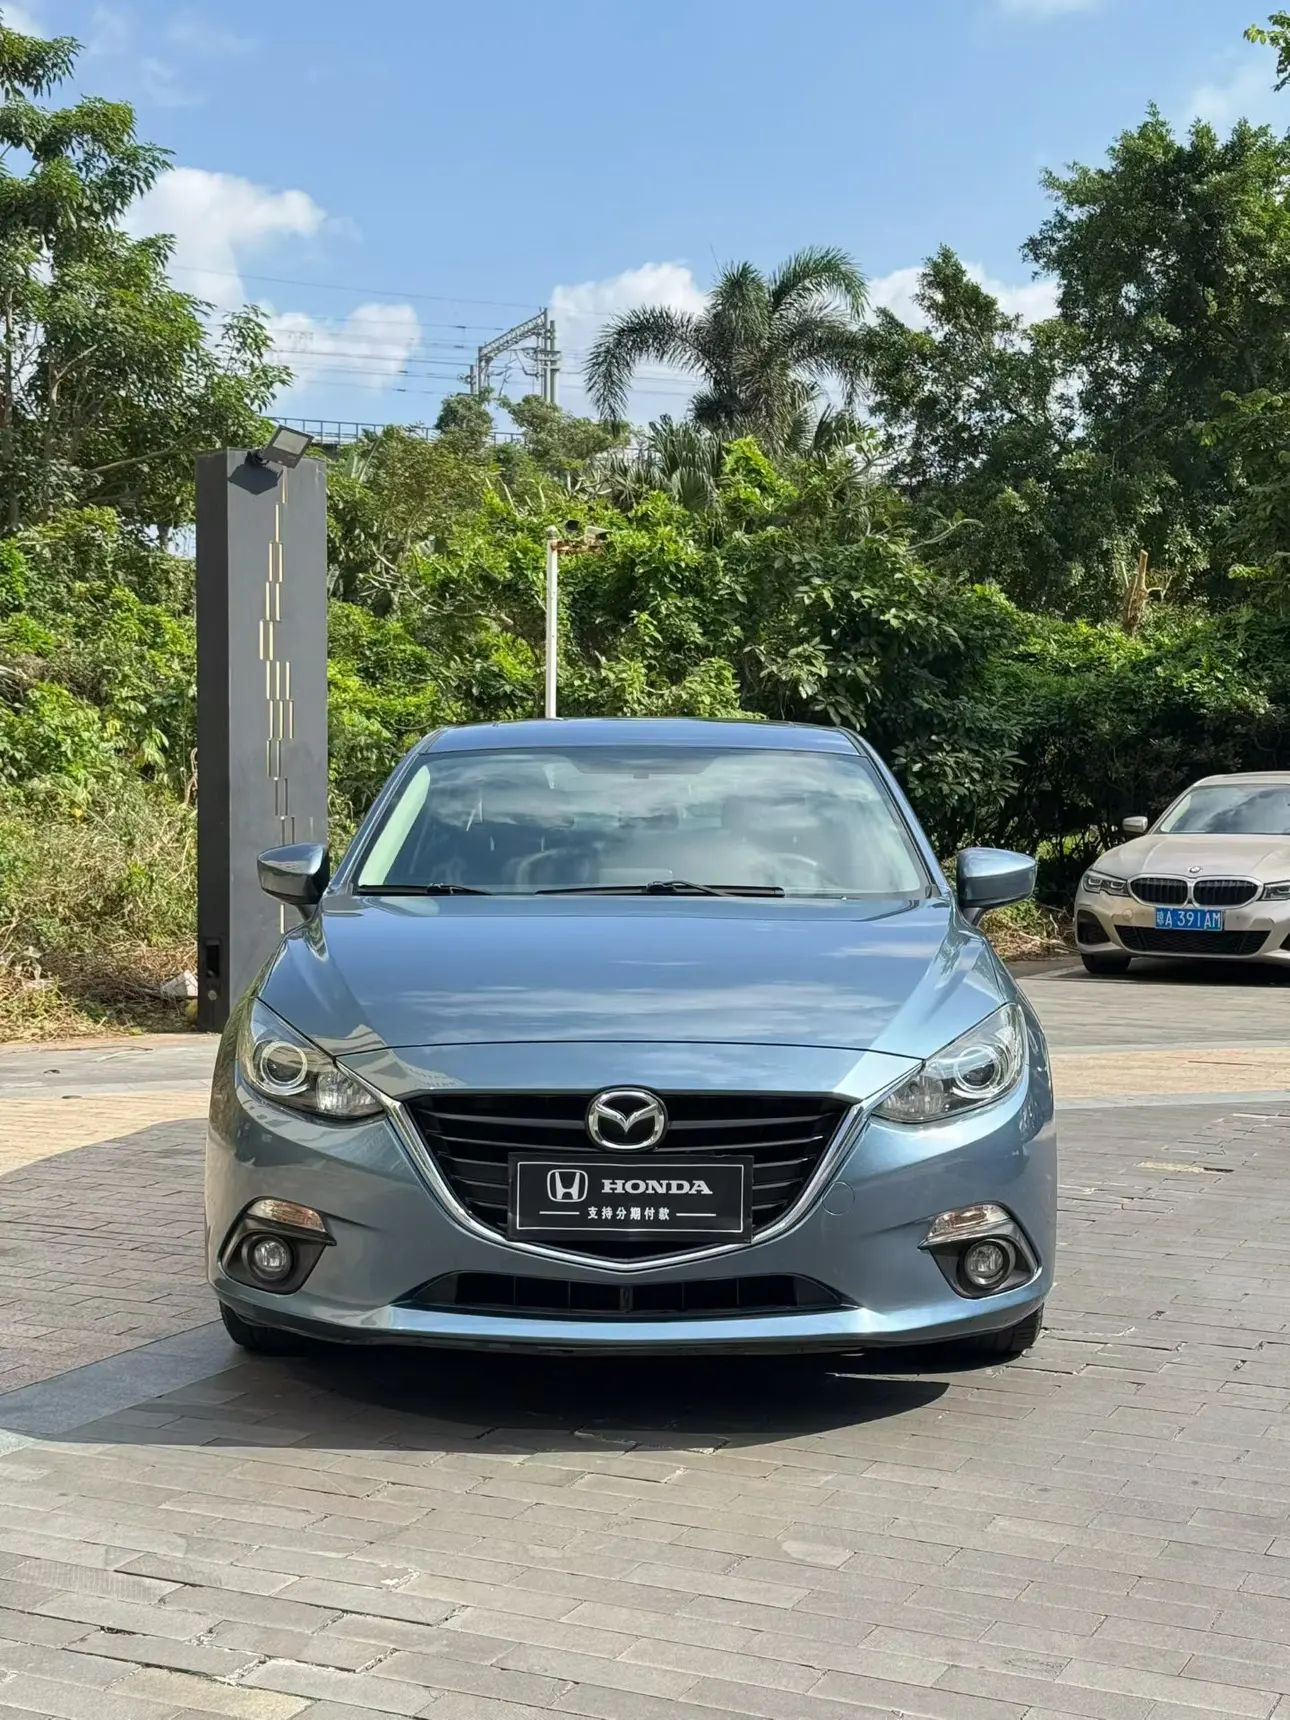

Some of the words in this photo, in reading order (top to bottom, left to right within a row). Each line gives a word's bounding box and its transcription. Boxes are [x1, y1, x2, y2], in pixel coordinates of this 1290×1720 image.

[601, 1179, 713, 1195] HONDA
[587, 1207, 670, 1220] 支持分期付款
